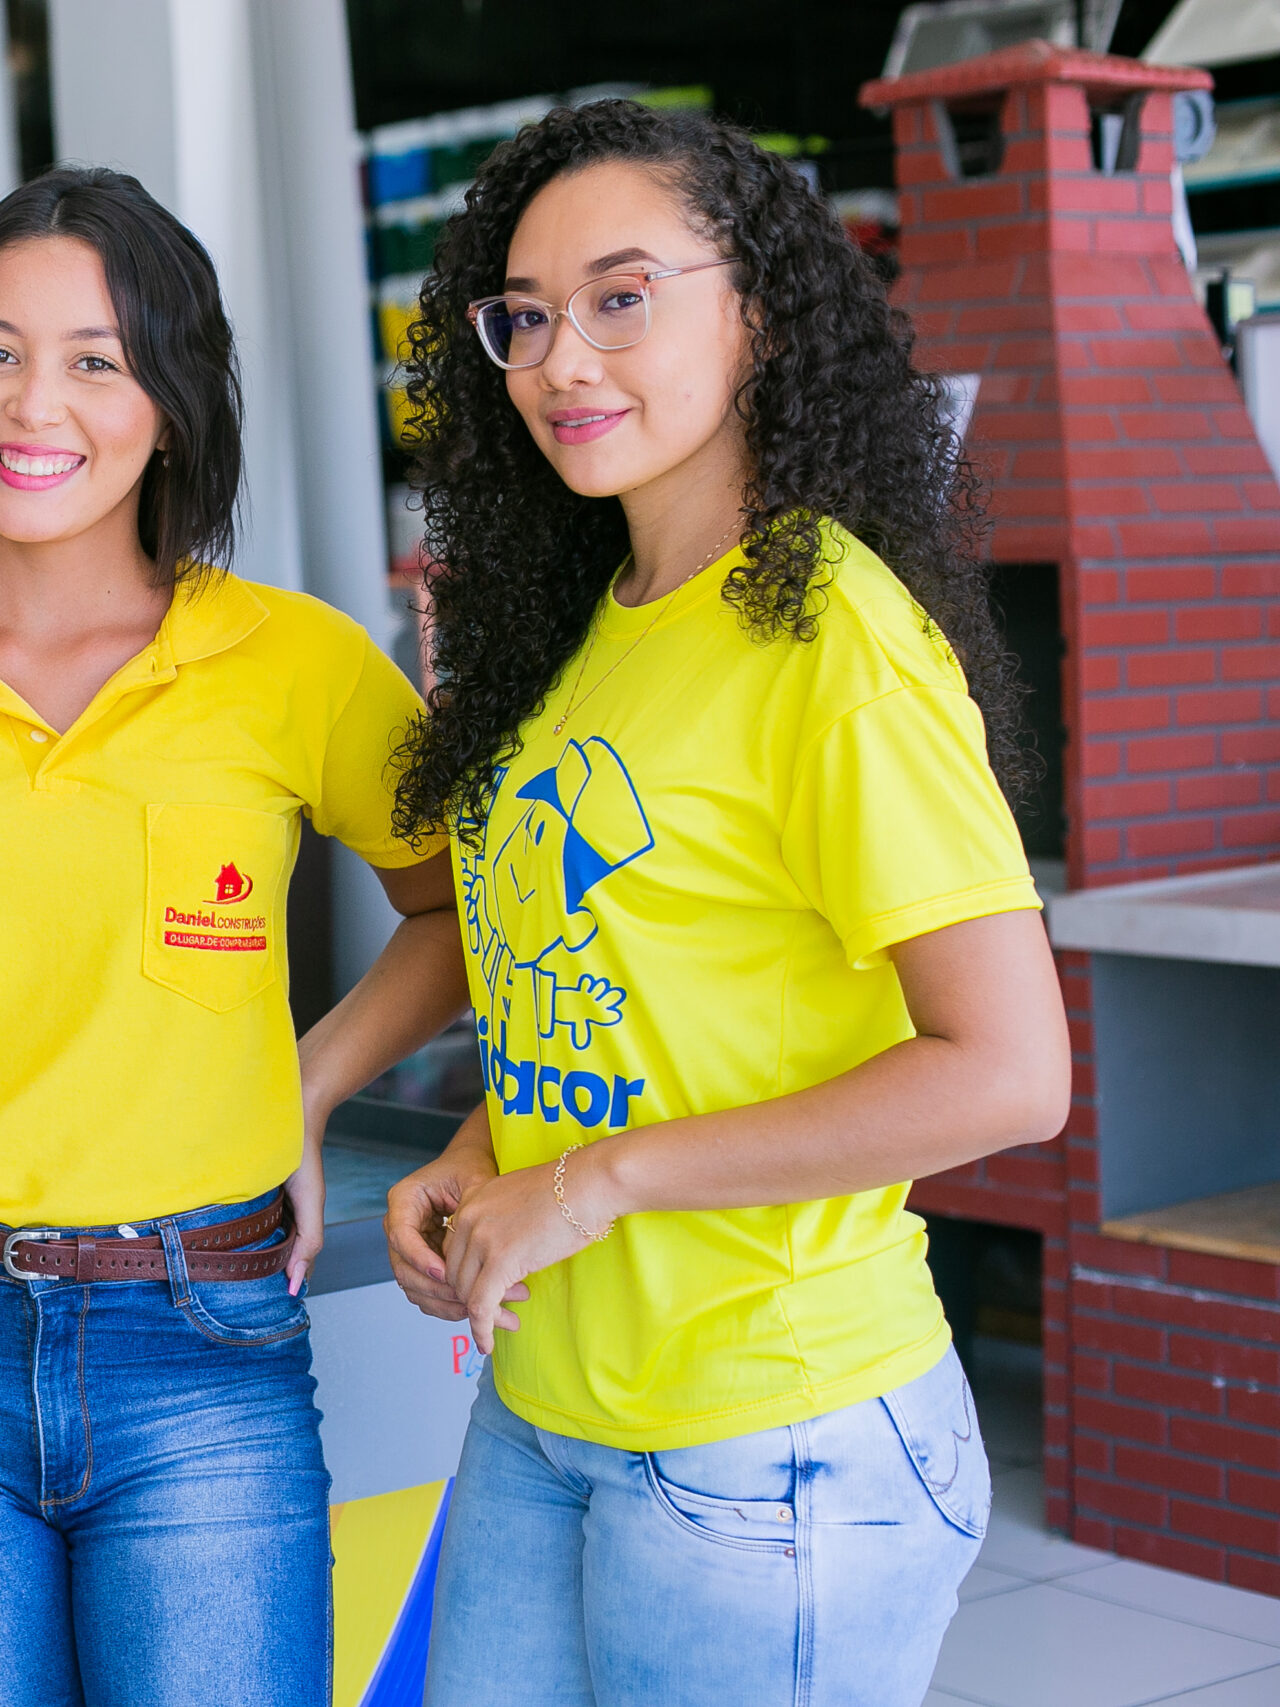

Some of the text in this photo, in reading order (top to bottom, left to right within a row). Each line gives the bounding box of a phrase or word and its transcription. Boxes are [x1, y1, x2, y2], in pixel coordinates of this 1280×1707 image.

[164, 906, 216, 928] Daniel
[170, 934, 177, 944] O
[178, 935, 205, 945] LUGAR
[207, 937, 218, 947] DE
